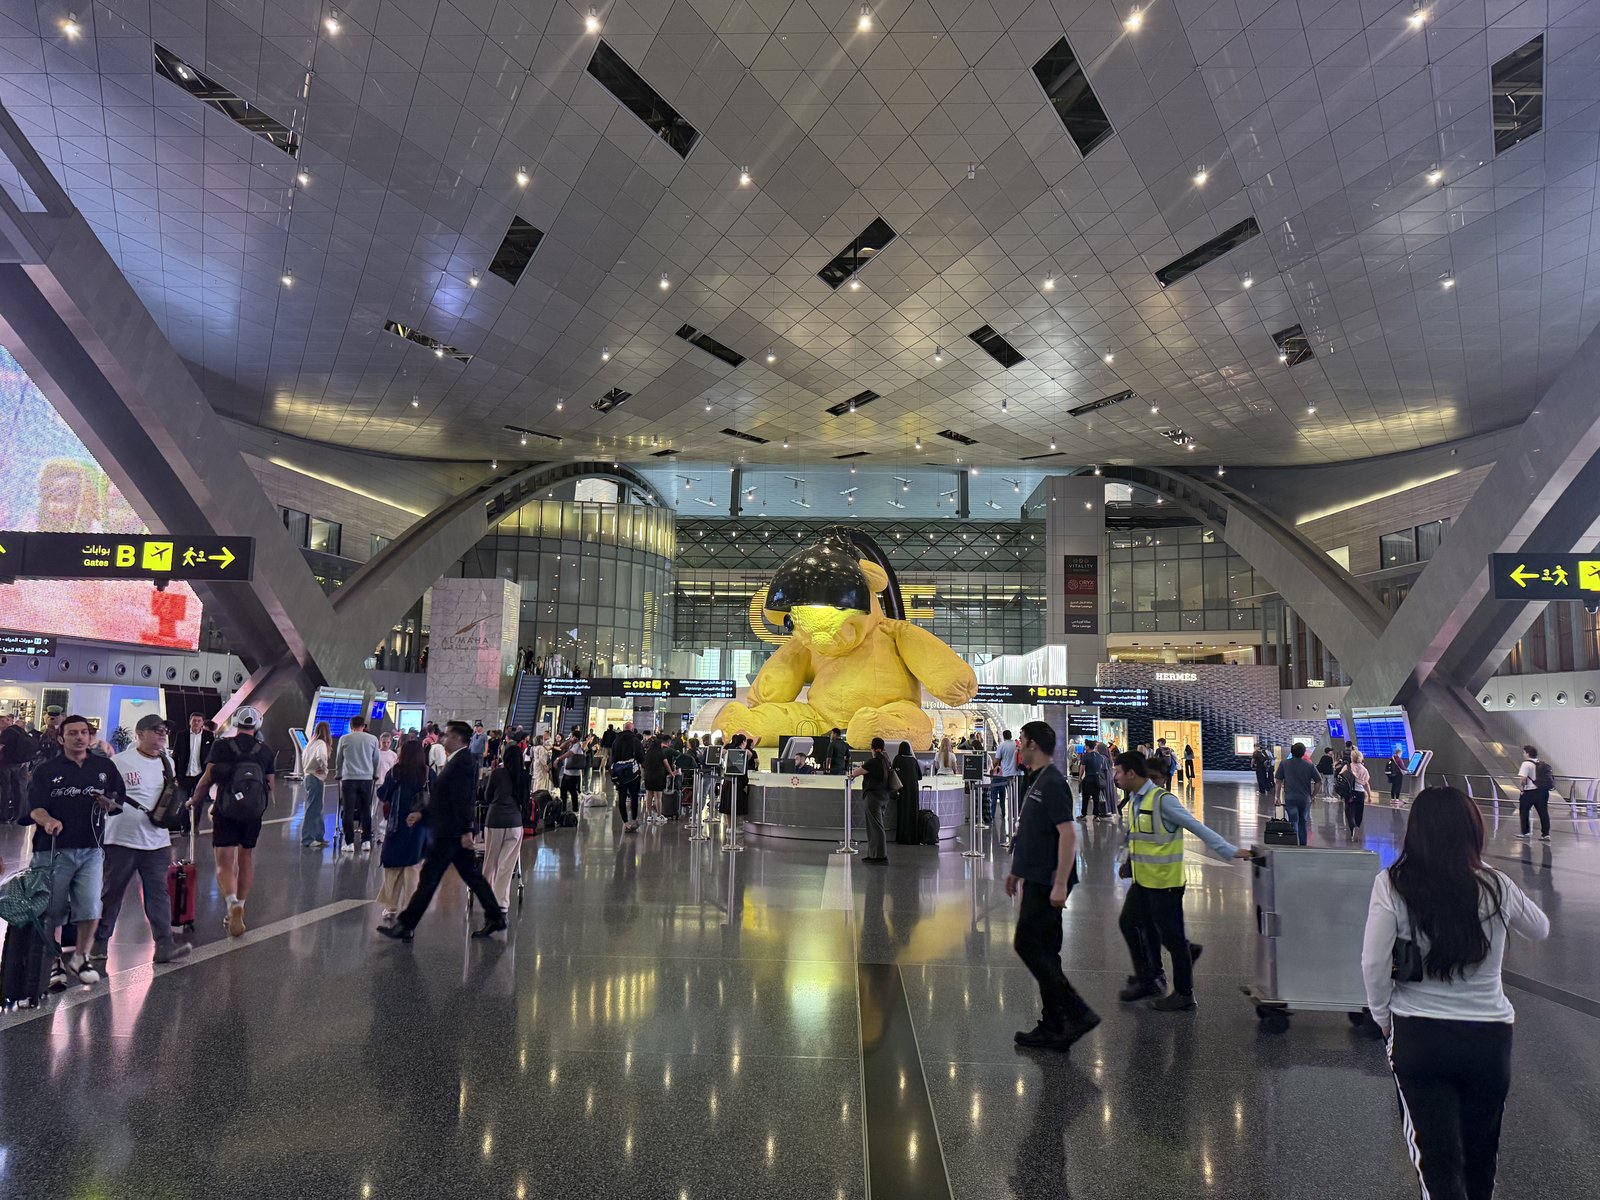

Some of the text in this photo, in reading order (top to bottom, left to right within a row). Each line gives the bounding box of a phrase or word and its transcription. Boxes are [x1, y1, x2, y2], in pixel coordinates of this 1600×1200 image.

[82, 544, 111, 556] بوابات
[116, 544, 136, 567] B
[83, 558, 109, 567] Gates
